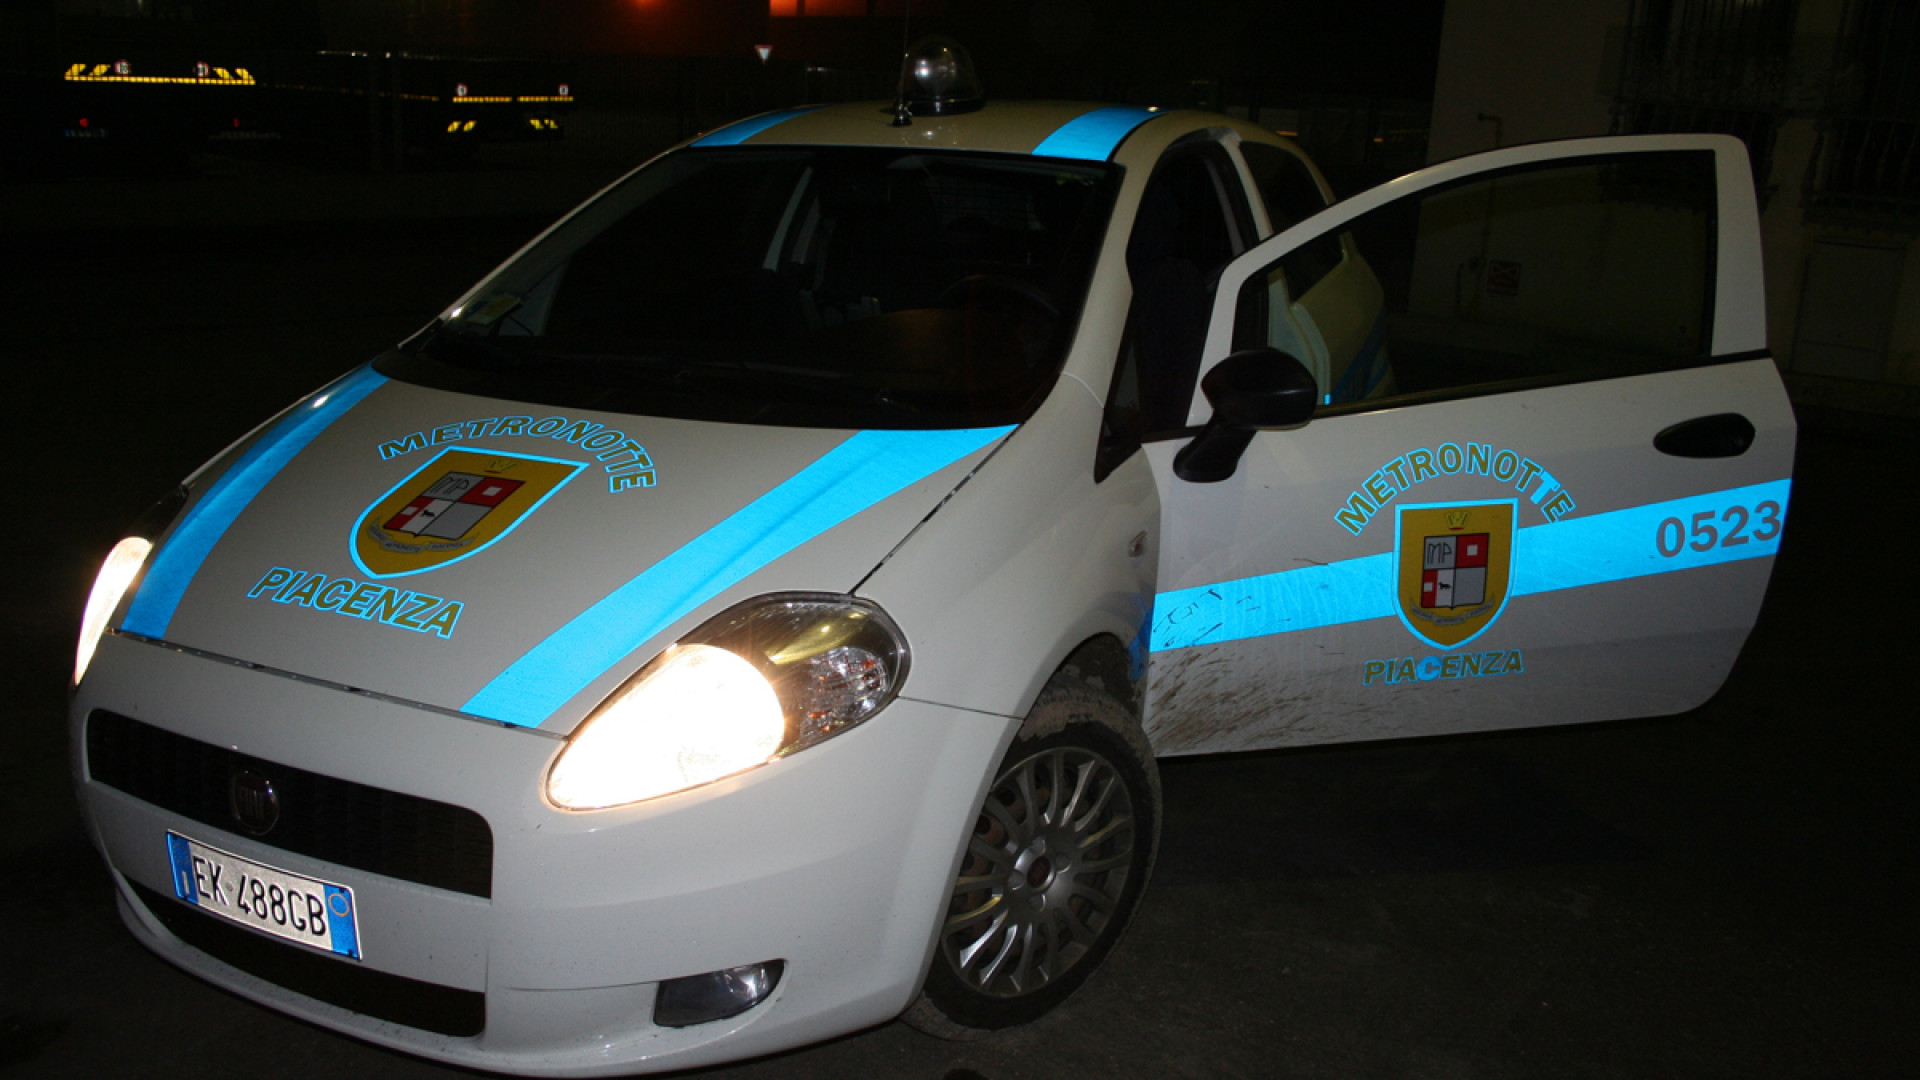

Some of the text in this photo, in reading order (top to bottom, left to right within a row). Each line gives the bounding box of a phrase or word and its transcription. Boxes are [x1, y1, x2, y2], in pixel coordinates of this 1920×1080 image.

[377, 415, 658, 494] METRONOTTE
[1334, 441, 1577, 536] METRONOTTE
[1655, 500, 1782, 558] 0523
[247, 566, 465, 640] PIACENZA
[1362, 649, 1525, 687] PIACENZA
[192, 855, 328, 937] EK 488GB
